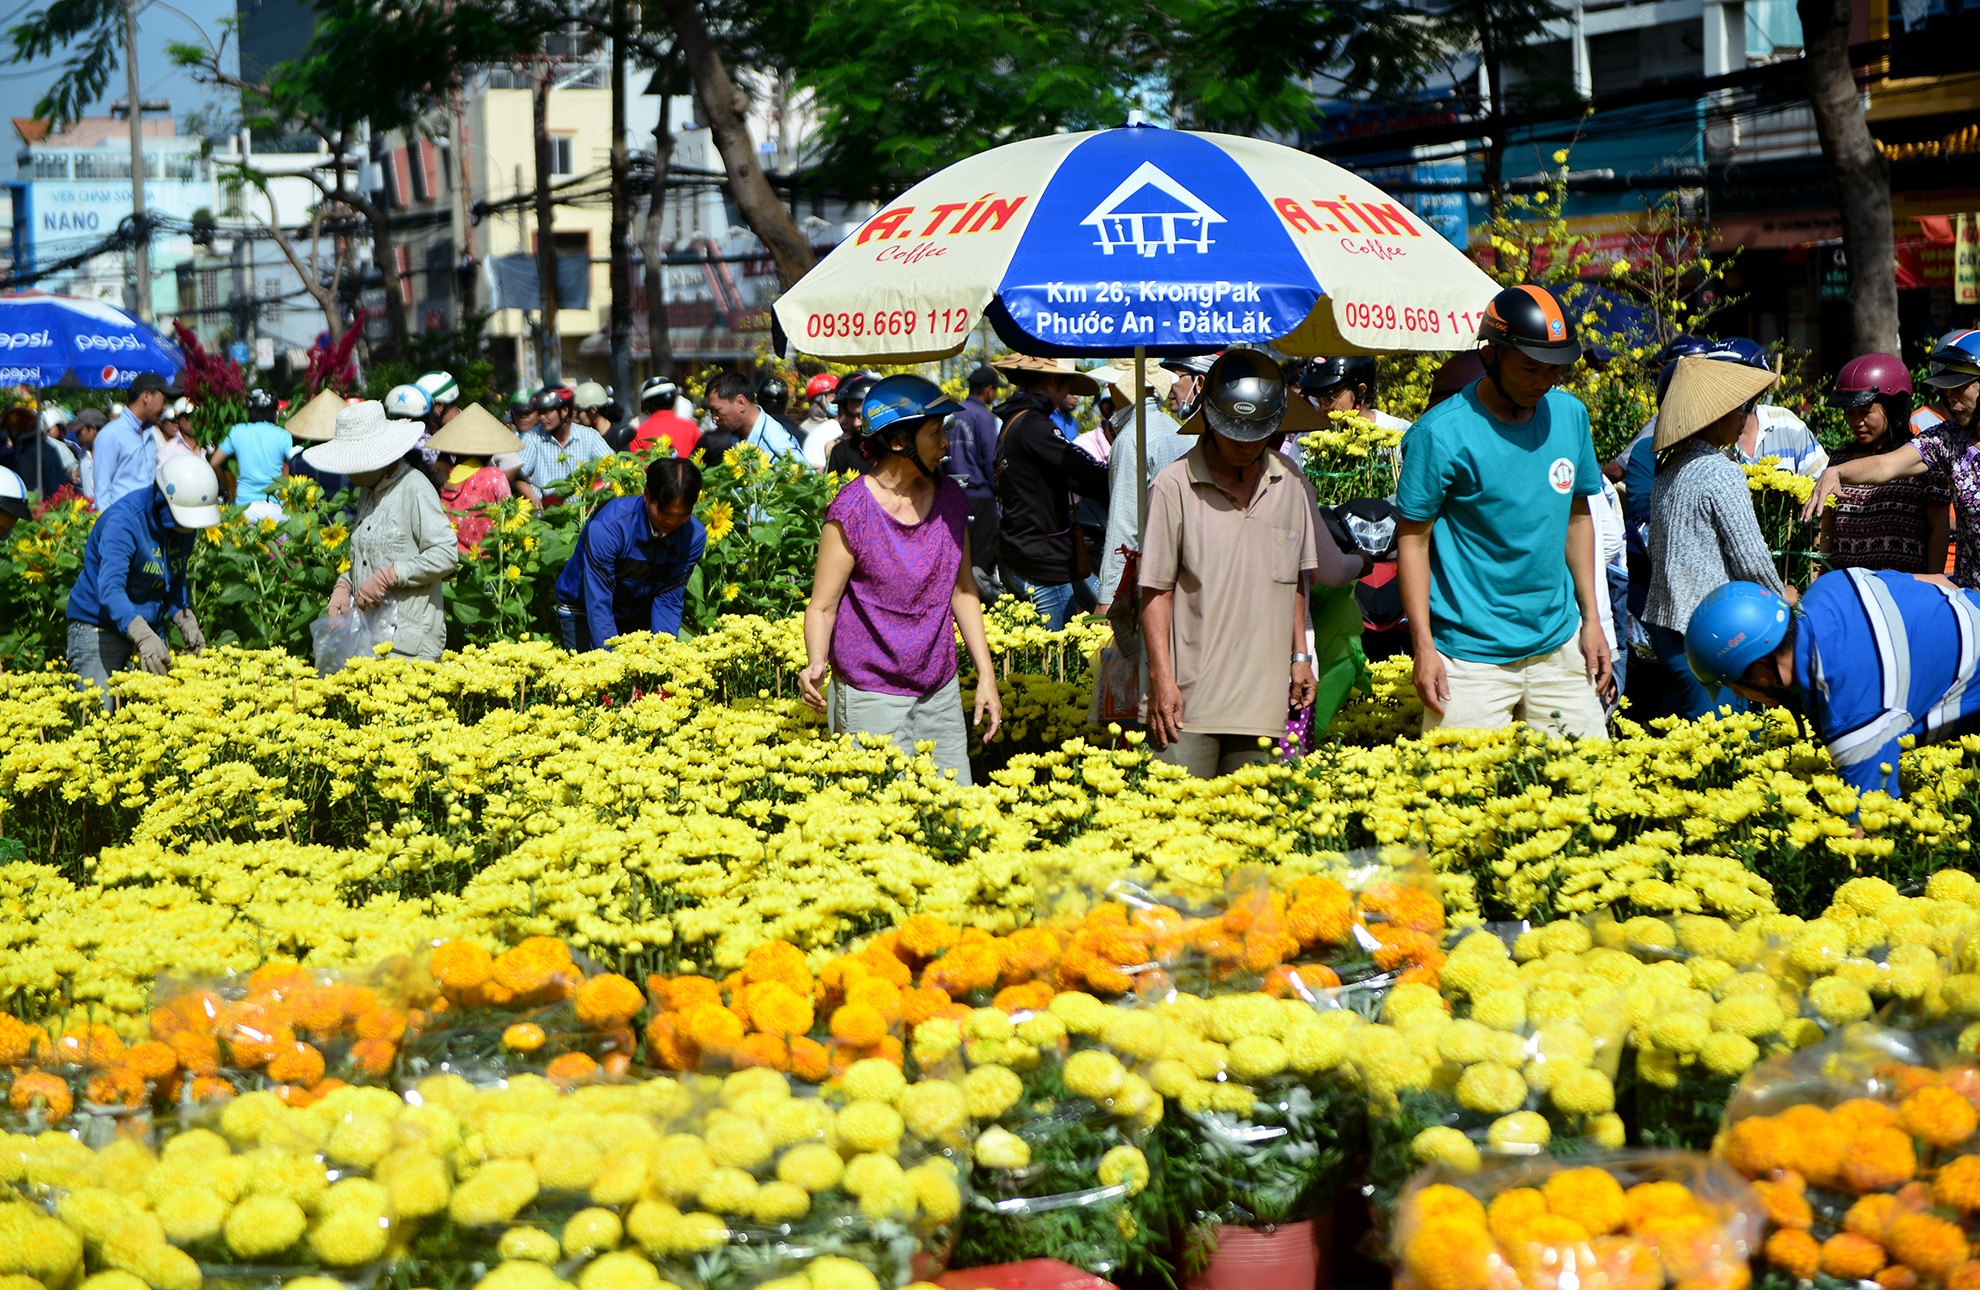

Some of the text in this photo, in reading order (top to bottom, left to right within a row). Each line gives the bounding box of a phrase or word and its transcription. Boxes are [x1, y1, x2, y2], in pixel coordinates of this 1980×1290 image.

[44, 210, 99, 231] NANO
[876, 241, 948, 265] Coffee
[1340, 238, 1407, 260] Coffee
[1047, 280, 1261, 307] Km 26, KrongPak
[807, 307, 969, 338] 0939.669 112
[1036, 310, 1115, 334] Phước
[1121, 311, 1155, 334] An
[1178, 310, 1273, 334] ĐăkLăk
[1345, 302, 1441, 334] 0939.669
[75, 333, 142, 352] pepsi
[1, 366, 41, 381] pepsi
